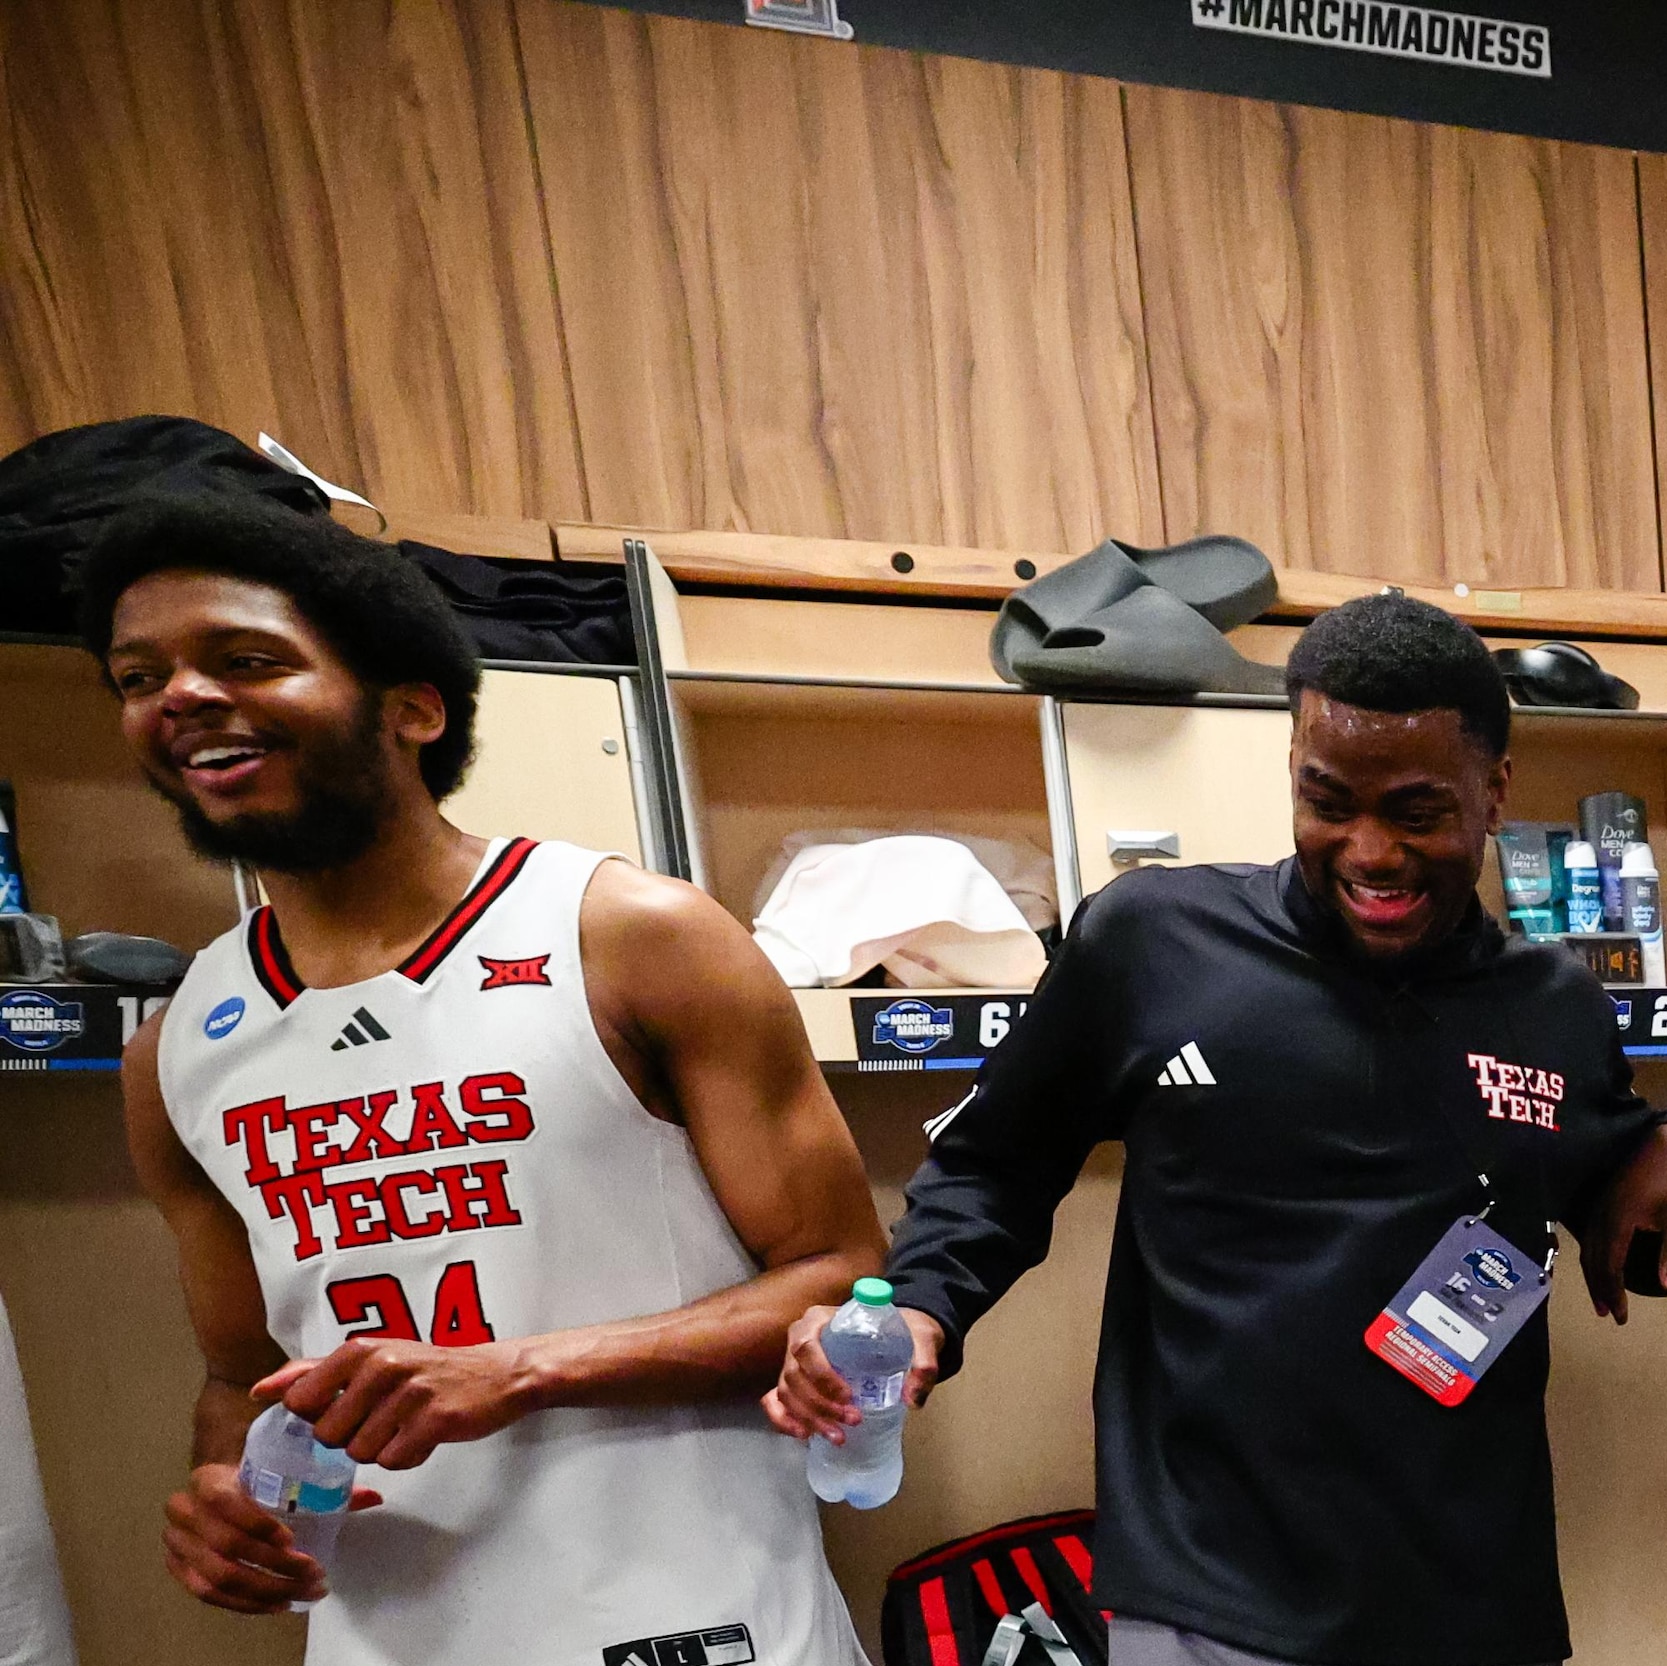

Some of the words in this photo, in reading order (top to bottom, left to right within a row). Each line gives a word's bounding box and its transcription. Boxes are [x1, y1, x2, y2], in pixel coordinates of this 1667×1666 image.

[1199, 0, 1544, 69] #MARCHMADNESS
[1600, 825, 1635, 841] Dove
[1601, 840, 1624, 849] MEN
[1512, 851, 1540, 862] Dove
[2, 1007, 55, 1020] MARCH
[890, 1013, 931, 1025] MARCH
[11, 1019, 81, 1032] MADNESS
[897, 1024, 950, 1036] MADNESS
[1467, 1052, 1566, 1104] TEXAS
[223, 1070, 537, 1186] TEXAS
[262, 1159, 522, 1260] TECH
[677, 1650, 688, 1663] L
